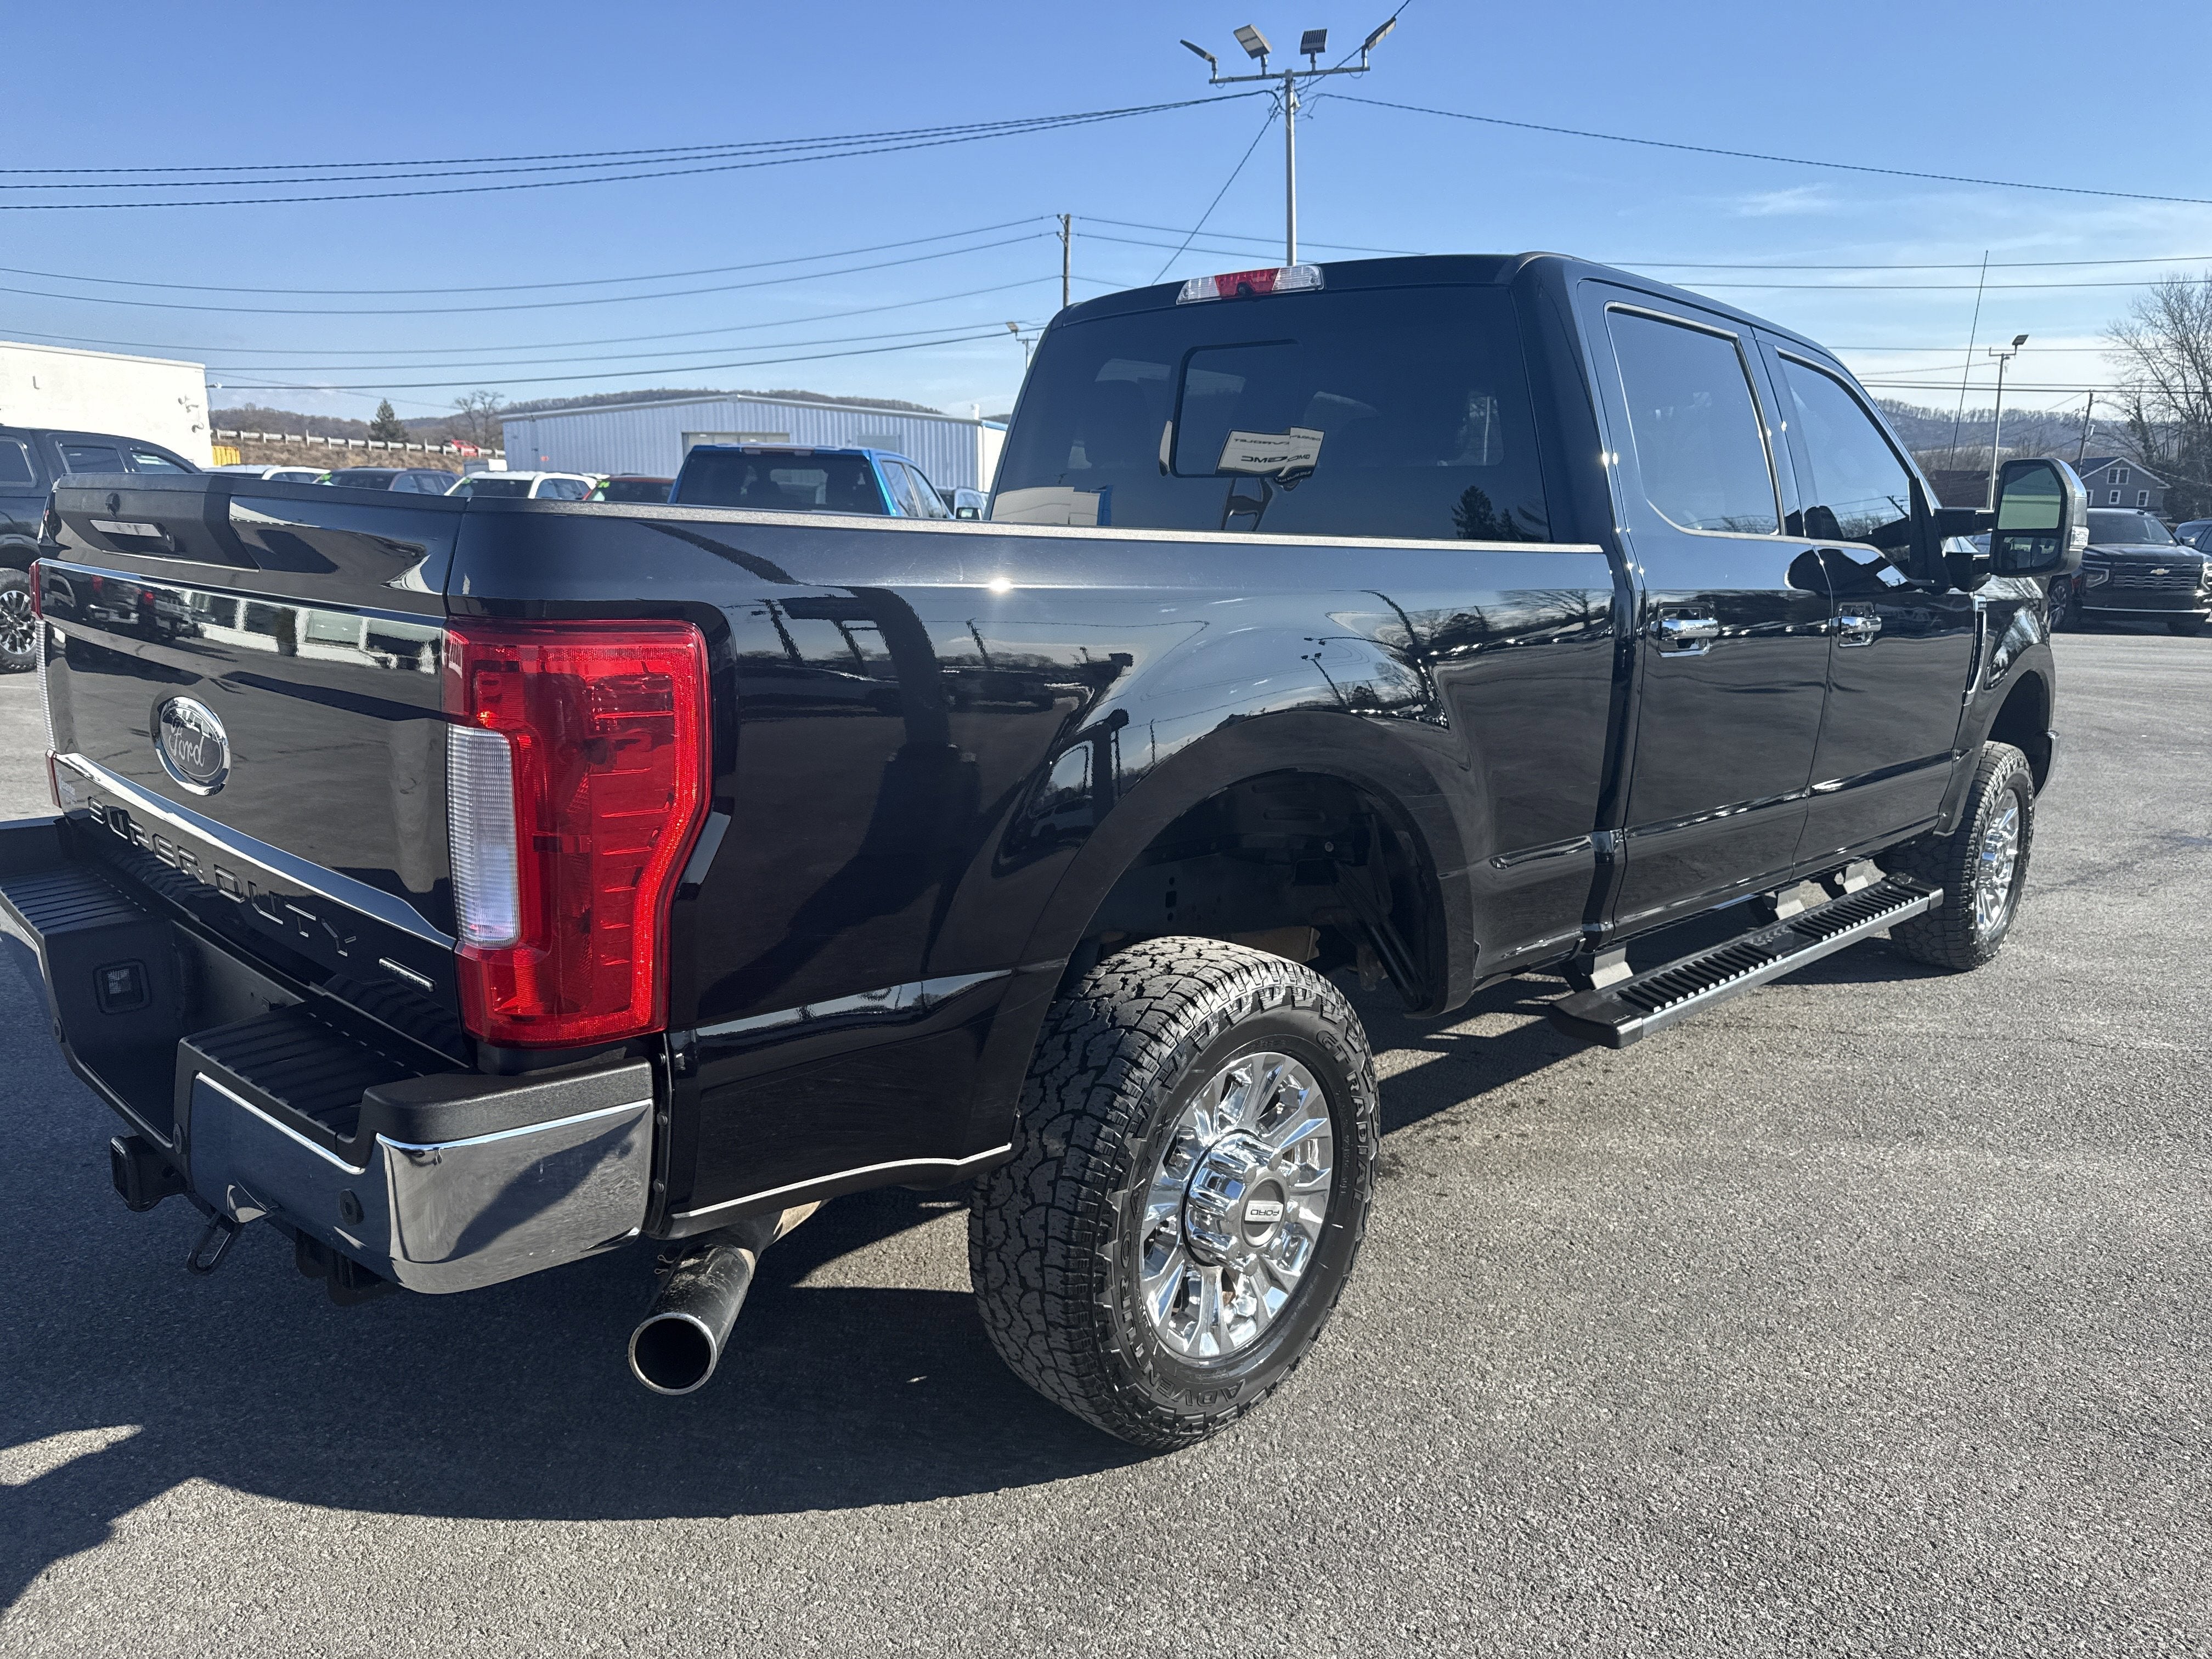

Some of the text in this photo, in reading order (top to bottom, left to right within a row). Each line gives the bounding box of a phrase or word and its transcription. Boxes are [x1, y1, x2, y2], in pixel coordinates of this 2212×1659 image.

[169, 713, 205, 768] Ford
[88, 796, 357, 957] SUPER DUTY
[1347, 1070, 1368, 1209] RADIAL
[1120, 1229, 1246, 1407] ADVENTURO
